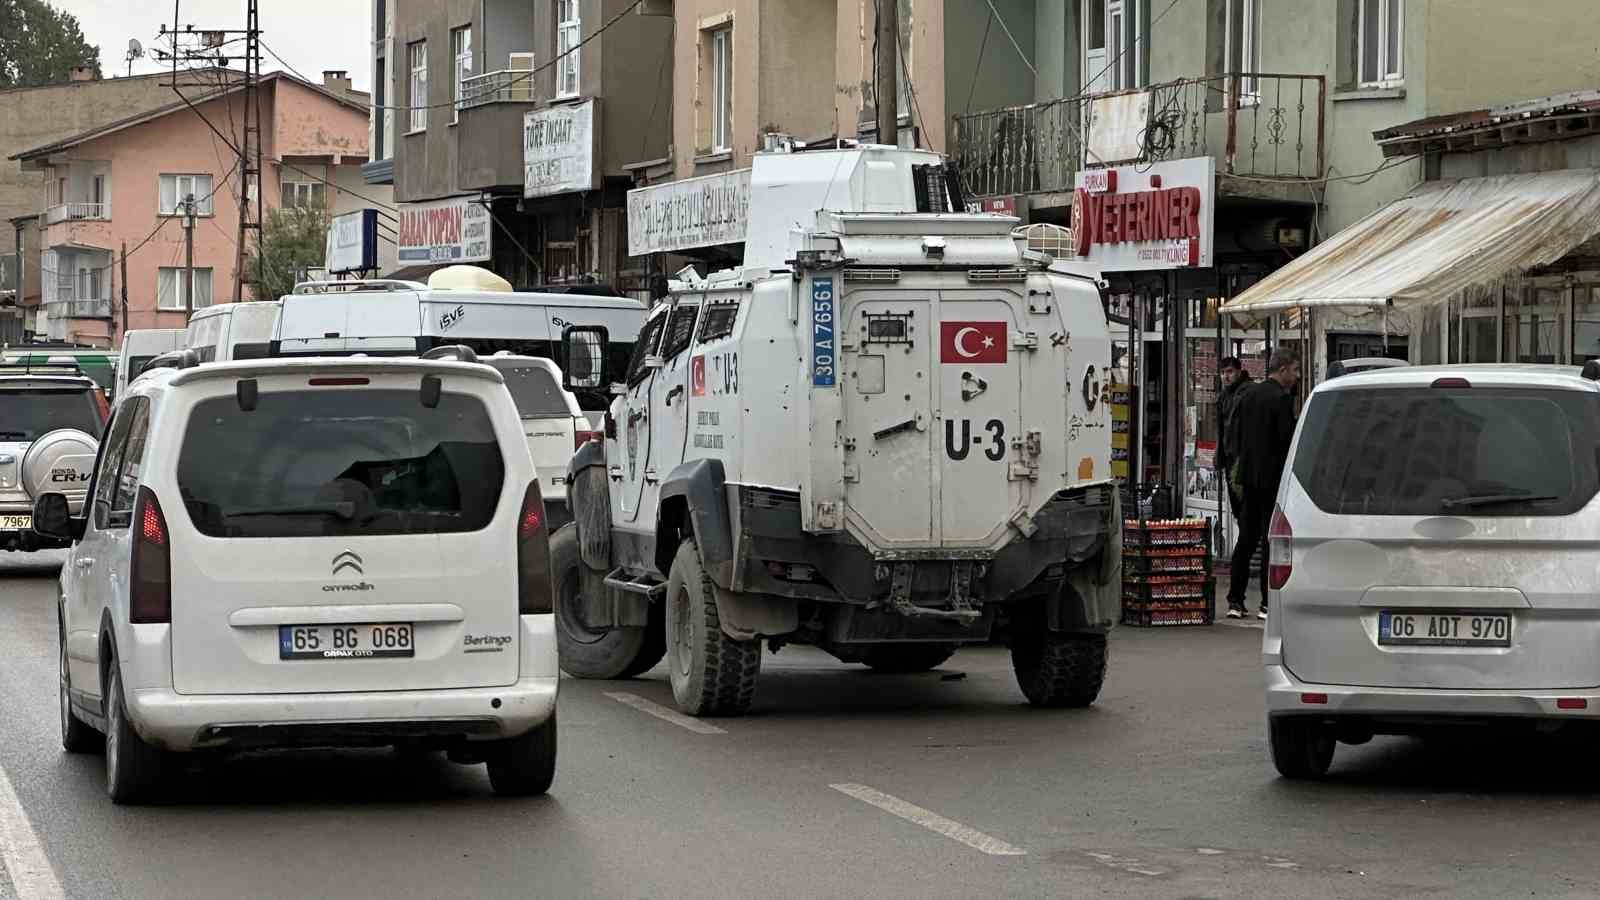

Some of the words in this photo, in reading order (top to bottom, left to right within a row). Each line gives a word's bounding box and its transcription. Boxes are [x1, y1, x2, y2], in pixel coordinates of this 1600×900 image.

[1089, 175, 1201, 244] VETERİNER
[814, 281, 832, 334] 76561
[816, 340, 832, 349] A
[724, 352, 738, 394] U-3
[816, 355, 833, 376] 30
[945, 419, 1006, 461] U-3
[52, 473, 92, 482] CR-V
[3, 516, 31, 527] 7967
[1393, 616, 1416, 637] 06
[1428, 616, 1461, 637] ADT
[1471, 618, 1505, 638] 970
[294, 628, 319, 650] 65
[333, 627, 358, 649] BG
[372, 627, 410, 648] 068
[464, 635, 512, 646] Berlingo
